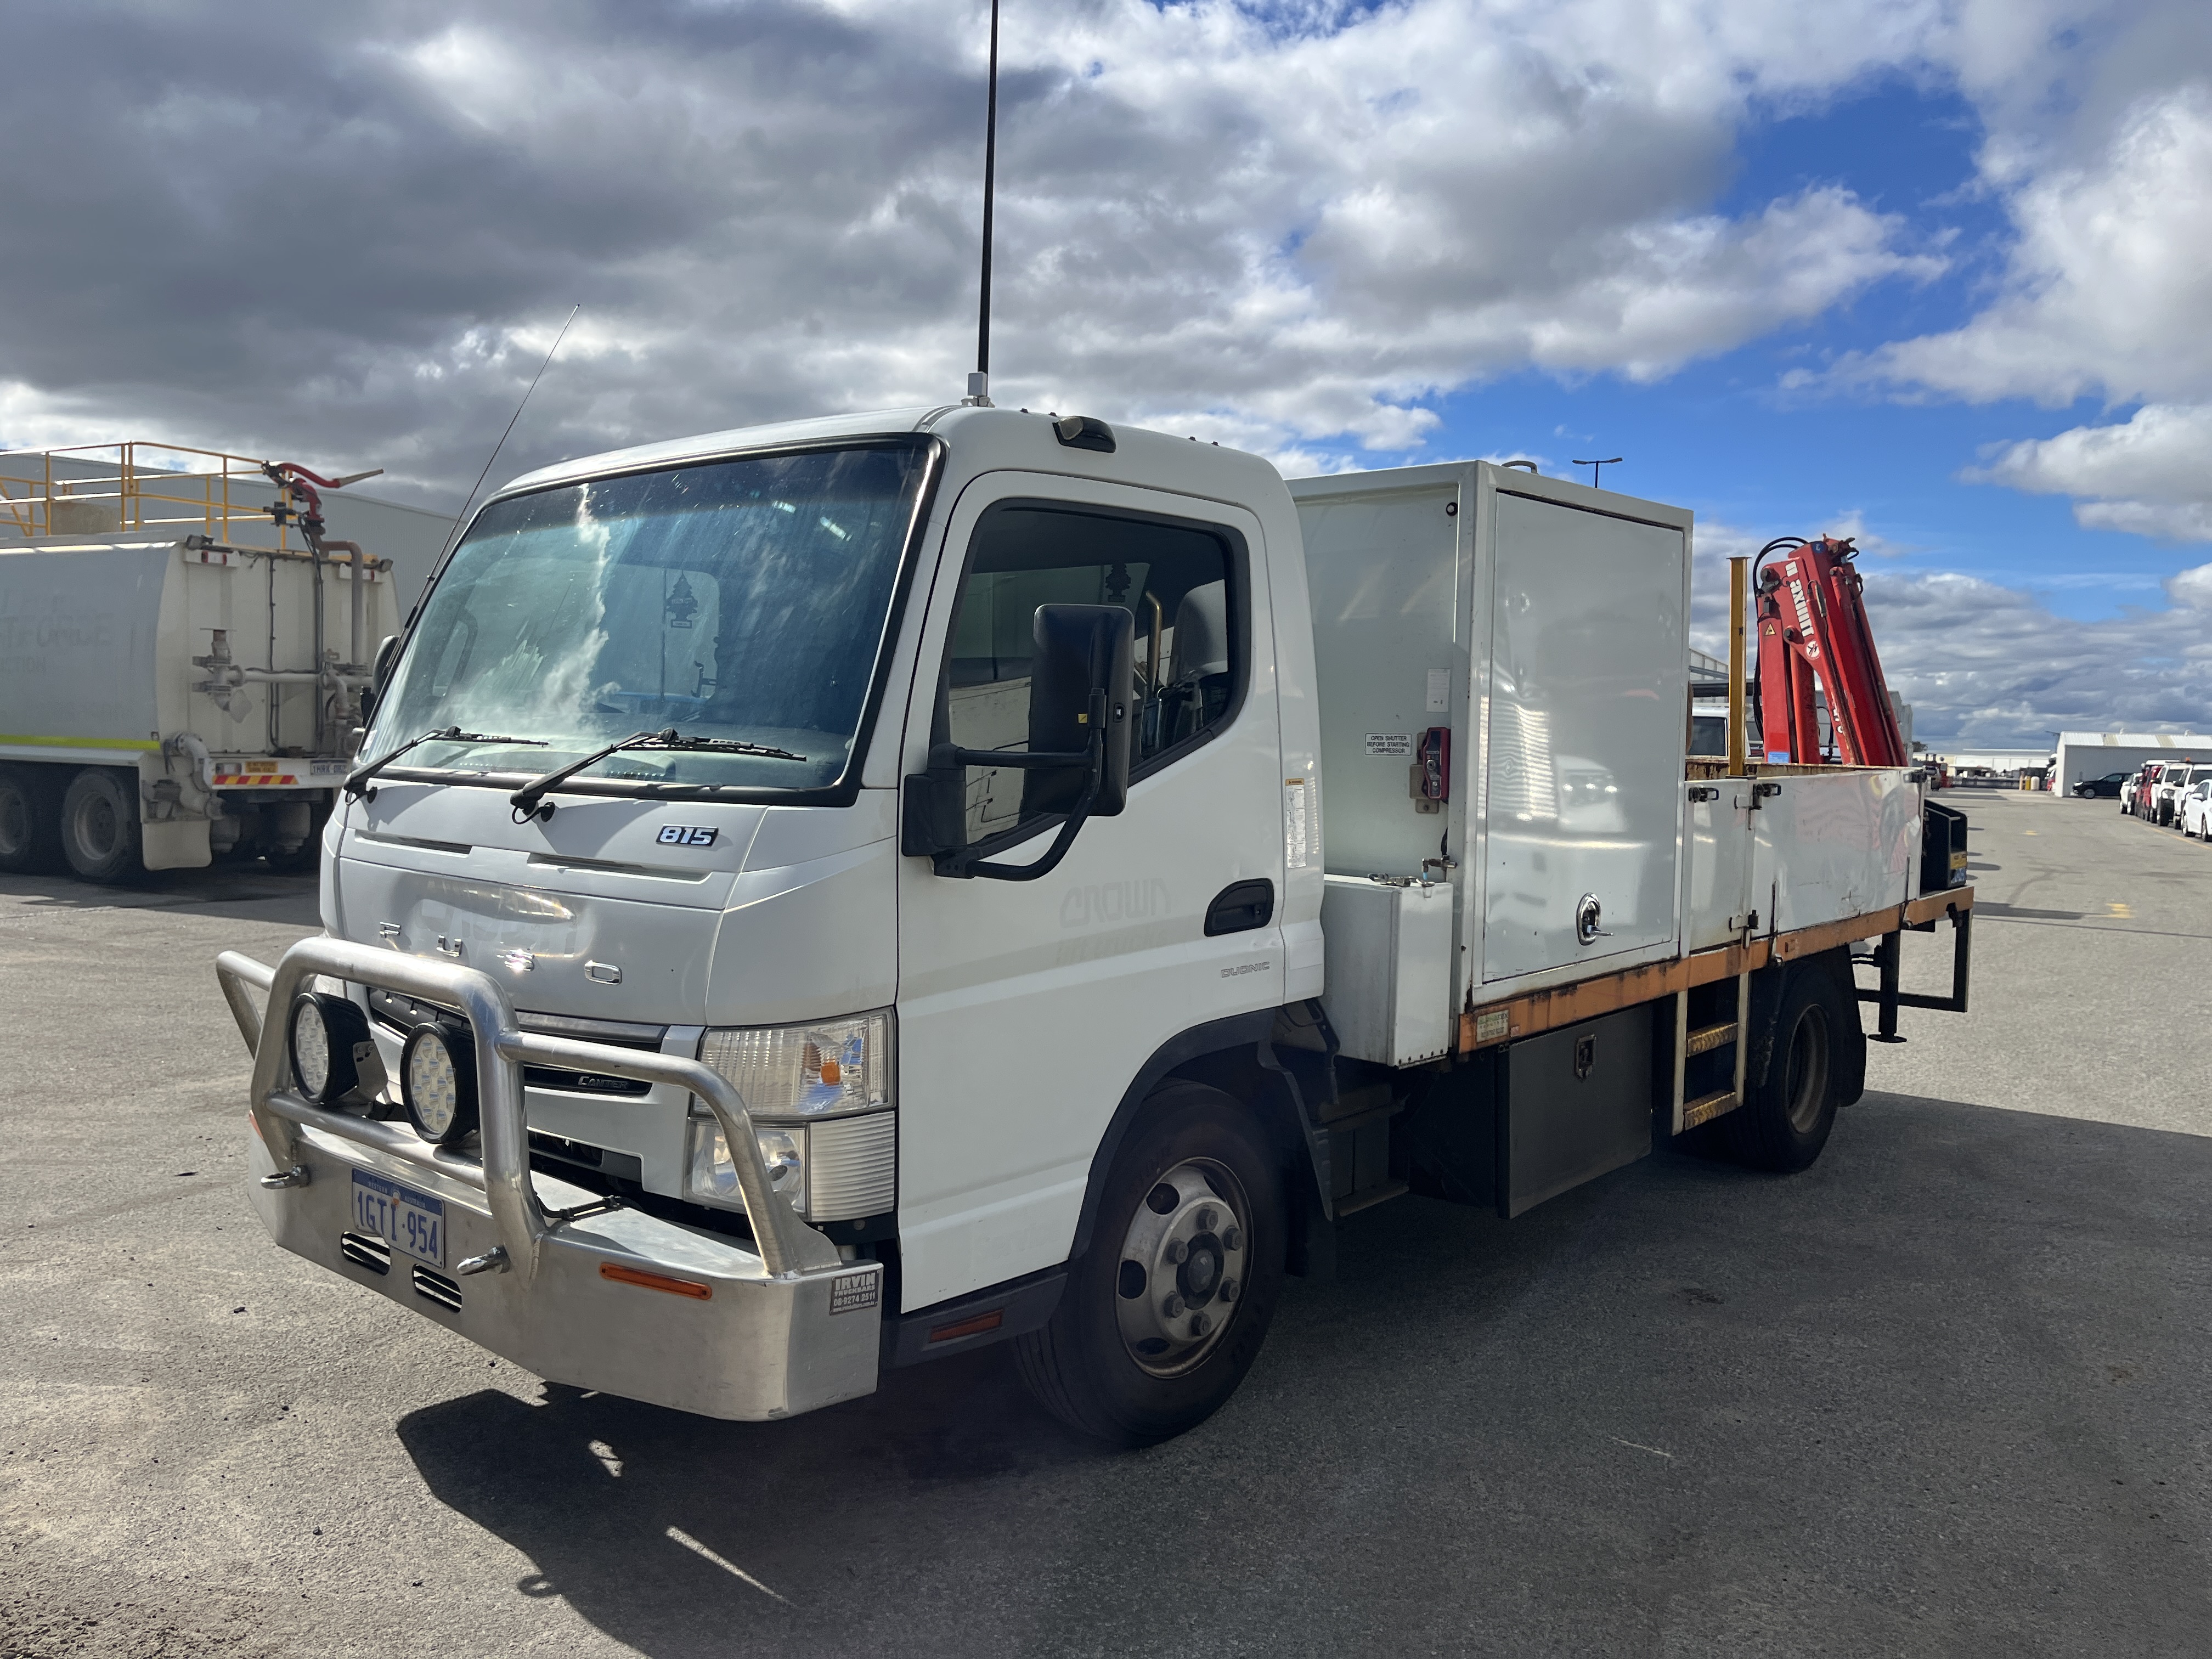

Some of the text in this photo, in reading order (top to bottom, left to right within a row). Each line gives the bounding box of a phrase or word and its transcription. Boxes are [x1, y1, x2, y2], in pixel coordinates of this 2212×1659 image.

[660, 826, 715, 845] 815
[1221, 961, 1270, 978] DUONIC
[835, 1272, 876, 1291] IRVIN
